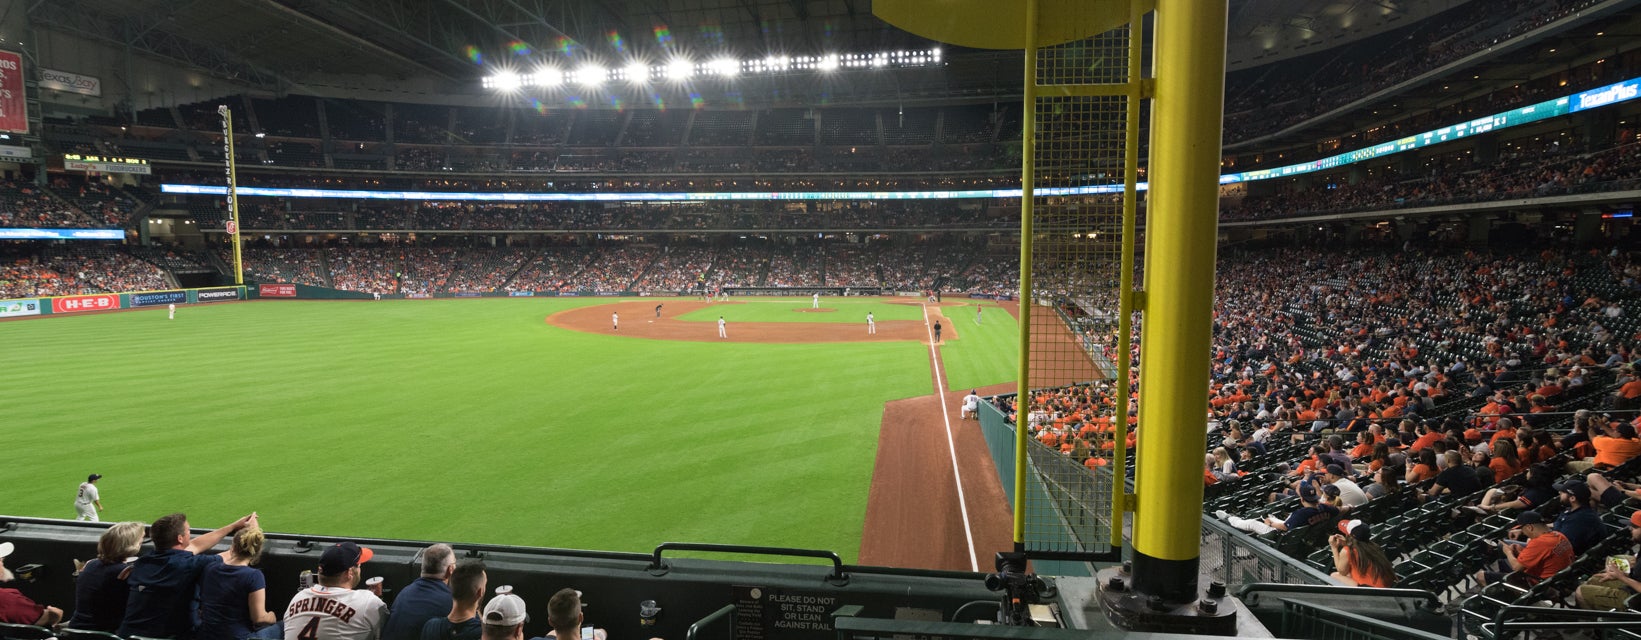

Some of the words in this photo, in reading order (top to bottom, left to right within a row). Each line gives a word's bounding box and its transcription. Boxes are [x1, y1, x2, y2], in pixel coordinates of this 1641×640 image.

[1579, 83, 1639, 109] TexanPlus
[198, 290, 237, 299] POWERADE
[769, 594, 802, 603] PLEASE
[803, 596, 816, 604] DO
[817, 597, 836, 605] NOT
[289, 597, 356, 624] SPRINGER
[780, 603, 796, 612] SIT,
[796, 604, 825, 613] STAND
[784, 612, 797, 620] OR
[798, 613, 822, 621] LEAN
[297, 616, 321, 640] 4
[774, 621, 811, 629] AGAINST
[812, 622, 833, 631] RAIL
